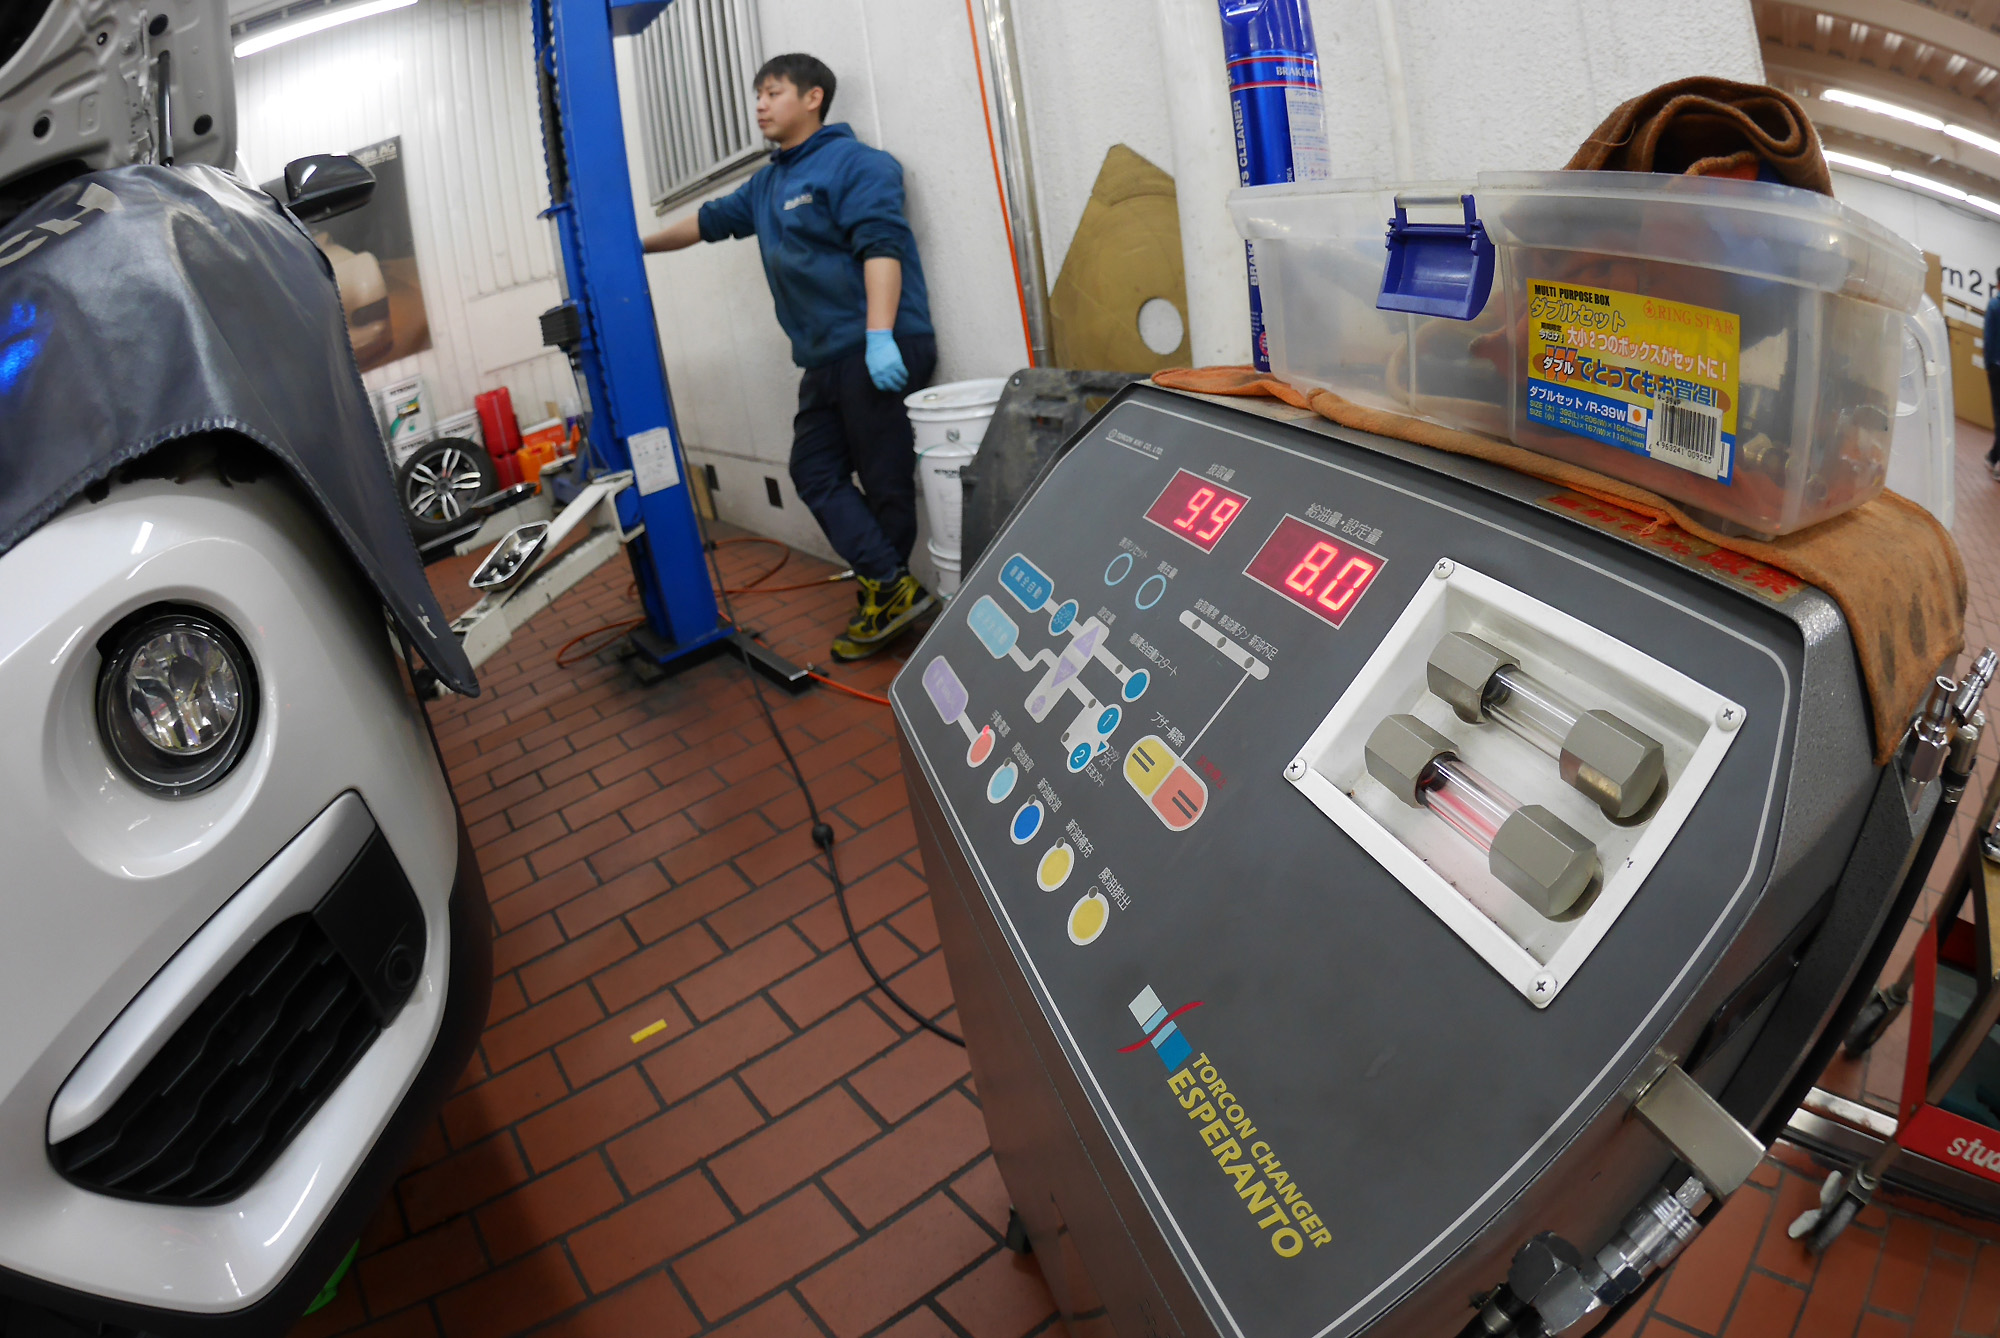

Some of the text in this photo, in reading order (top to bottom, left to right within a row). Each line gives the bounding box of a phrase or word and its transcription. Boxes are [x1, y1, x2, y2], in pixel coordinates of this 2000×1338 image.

[1233, 100, 1247, 166] CLEANER
[1530, 296, 1626, 333] ダブルセット
[1534, 284, 1610, 307] MULTI PURPOSE BOX
[1659, 305, 1735, 335] RING STAR
[1543, 356, 1575, 376] ダブル
[1529, 385, 1627, 423] ダブルセット /R-39W
[1173, 488, 1240, 541] 9.9
[1305, 502, 1384, 546] 給油量・設定量
[1285, 541, 1374, 612] 8.0
[1102, 714, 1114, 728] 1
[1074, 749, 1086, 764] 2
[1065, 818, 1095, 859] 新油補充
[1098, 866, 1132, 912] 廃油排出
[1167, 1067, 1304, 1259] ESPERANTO
[1192, 1052, 1333, 1249] TORCON CHANGER
